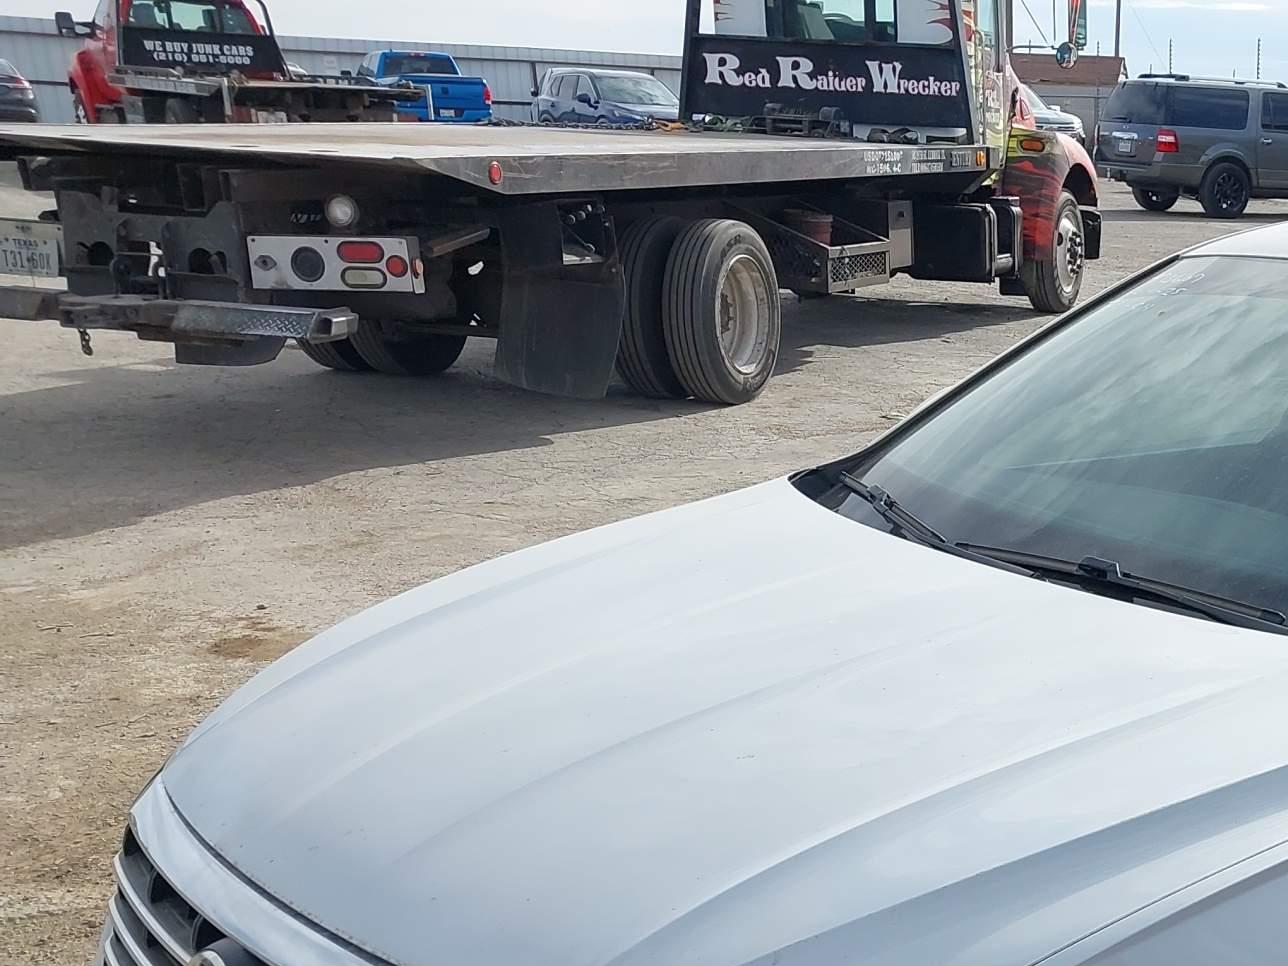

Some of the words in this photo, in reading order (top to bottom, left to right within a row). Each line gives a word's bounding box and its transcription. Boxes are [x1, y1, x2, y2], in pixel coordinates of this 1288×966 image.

[143, 40, 163, 51] WE
[165, 42, 189, 53] BUY
[192, 44, 222, 55] JUNK
[223, 45, 254, 57] CARS
[702, 52, 771, 88] Red
[865, 60, 960, 97] Wrecker
